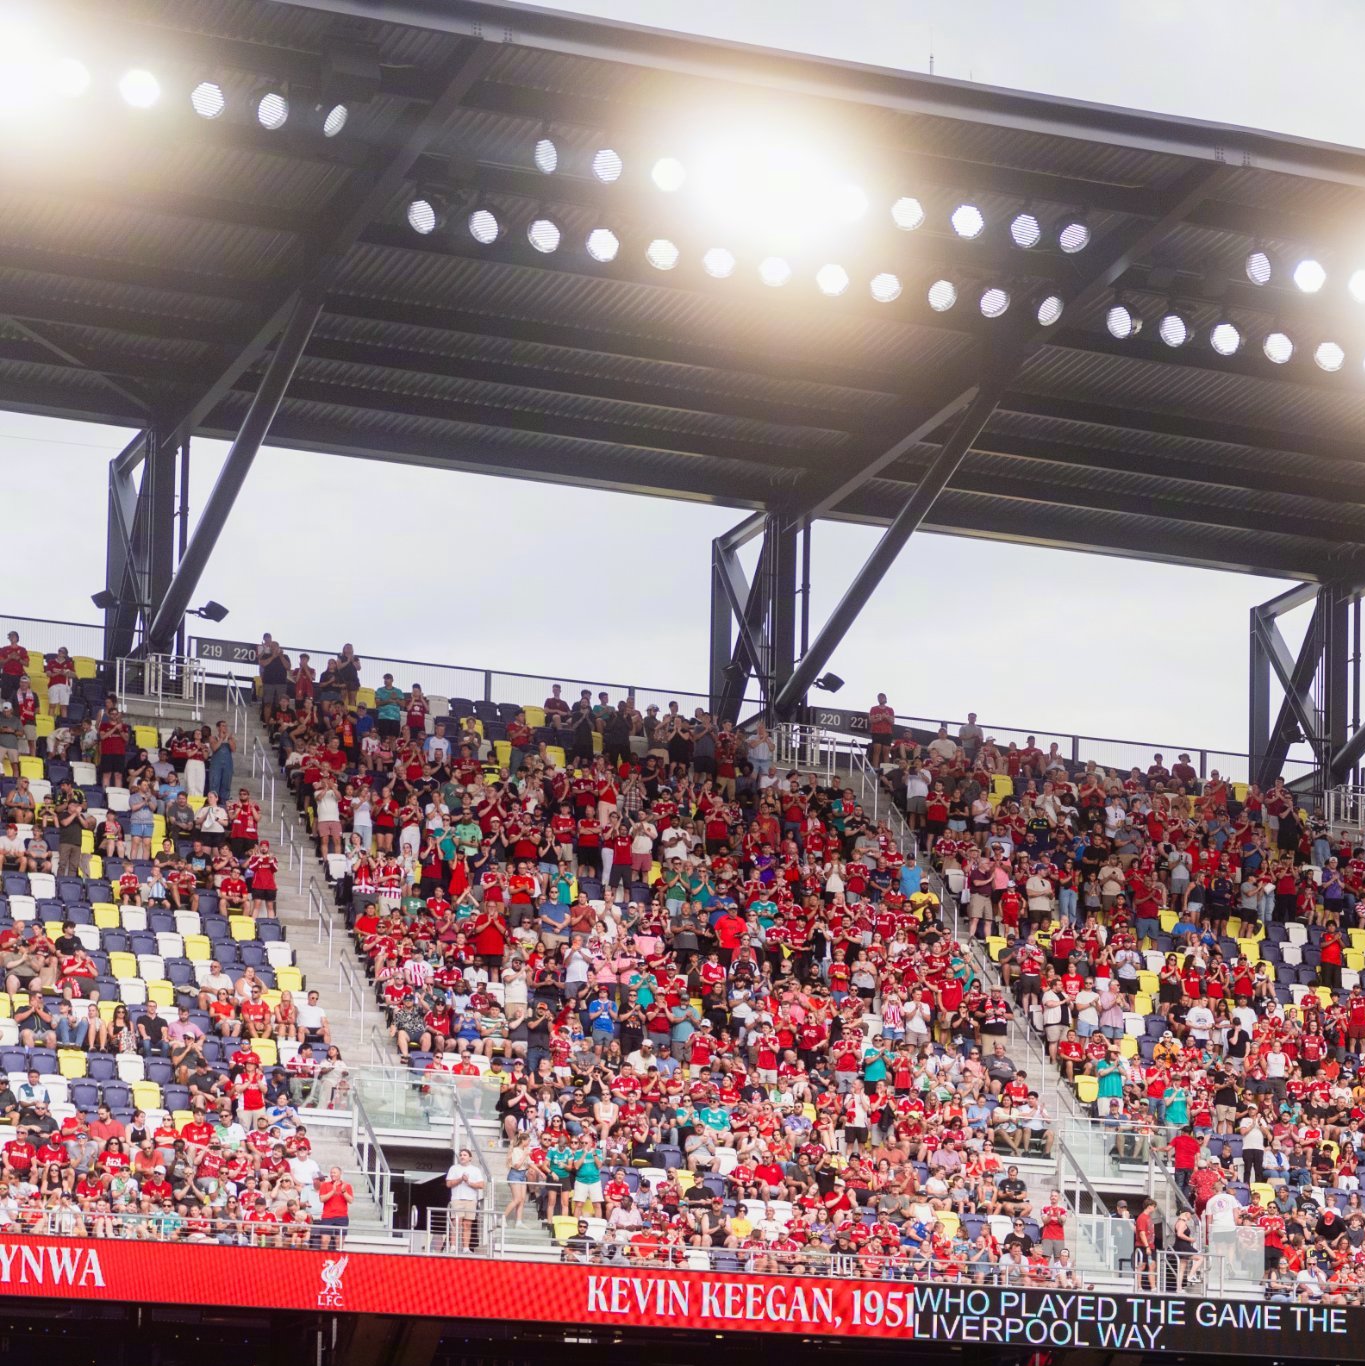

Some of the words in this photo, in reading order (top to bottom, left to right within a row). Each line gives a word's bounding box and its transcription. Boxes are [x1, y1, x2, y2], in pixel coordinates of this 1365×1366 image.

[202, 644, 222, 657] 219
[233, 647, 256, 661] 220
[820, 713, 840, 726] 220
[850, 716, 868, 729] 221
[0, 1244, 106, 1288] YNWA
[588, 1276, 690, 1317] KEVIN
[700, 1281, 842, 1328] KEEGAN,
[851, 1289, 914, 1328] 1951
[914, 1287, 990, 1315] WHO
[1001, 1291, 1118, 1323] PLAYED
[1127, 1298, 1185, 1326] THE
[1196, 1301, 1281, 1330] GAME
[1290, 1307, 1347, 1334] THE
[914, 1312, 1089, 1346] LIVERPOOL
[1097, 1322, 1166, 1350] WAY.
